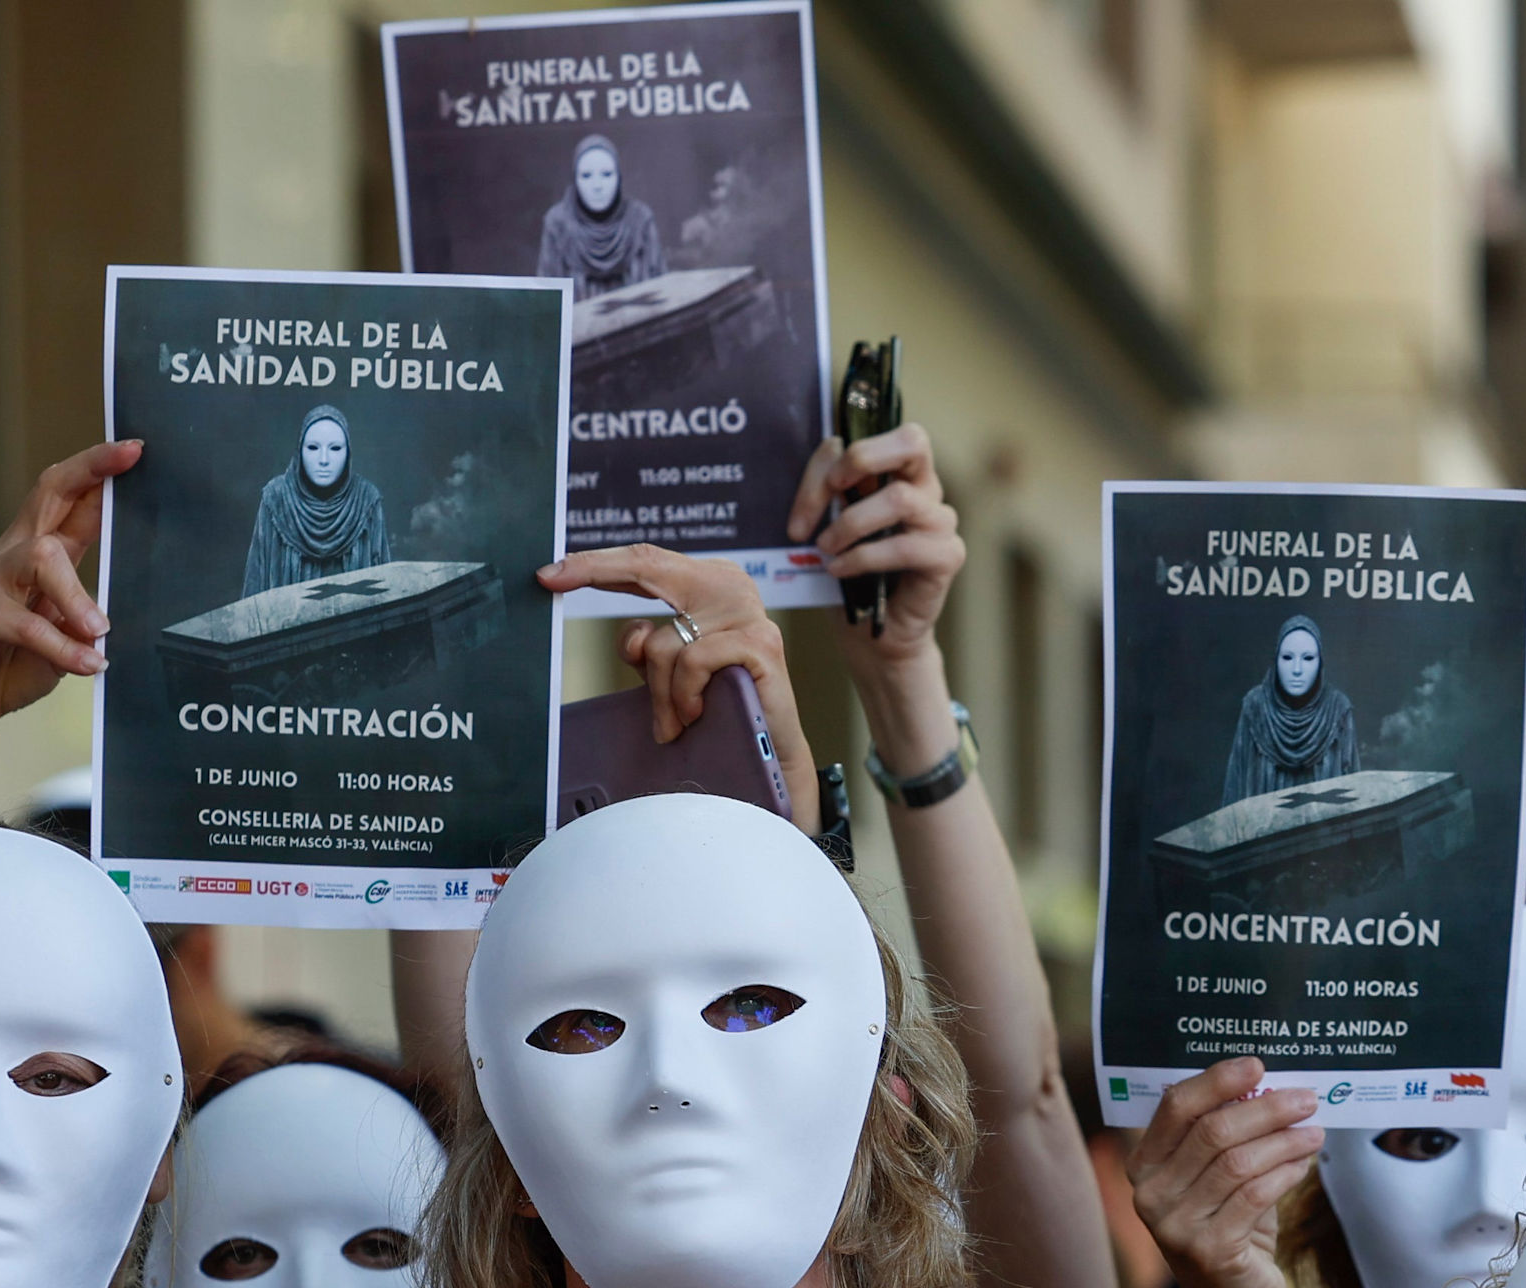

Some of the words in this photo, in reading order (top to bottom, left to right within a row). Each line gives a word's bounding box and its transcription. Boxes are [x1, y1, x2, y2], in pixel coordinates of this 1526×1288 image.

[487, 55, 612, 89] FUNERAL
[620, 52, 658, 79] DE
[665, 48, 702, 76] LA
[455, 89, 596, 128] SANITAT
[608, 80, 752, 118] PÚBLICA
[216, 318, 350, 347] FUNERAL
[363, 323, 400, 348] DE
[412, 323, 448, 350] LA
[171, 353, 337, 387] SANIDAD
[350, 351, 504, 392] PÚBLICA
[571, 398, 747, 441] CENTRACIÓ
[639, 467, 681, 486] 11:00
[684, 464, 744, 483] HORES
[637, 506, 661, 523] DE
[664, 502, 737, 522] SANITAT
[1207, 530, 1324, 558] FUNERAL
[1335, 533, 1372, 559] DE
[1382, 534, 1419, 561] LA
[1167, 566, 1311, 597] SANIDAD
[1323, 561, 1474, 603] PÚBLICA
[178, 703, 473, 740] CONCENTRACIÓN
[195, 768, 203, 784] 1
[209, 768, 232, 786] DE
[238, 769, 298, 788] JUNIO
[338, 772, 381, 791] 11:00
[388, 774, 454, 793] HORAS
[198, 808, 323, 830] CONSELLERIA
[329, 814, 353, 831] DE
[359, 815, 445, 834] SANIDAD
[209, 833, 247, 846] (CALLE
[251, 835, 287, 847] MICER
[289, 834, 332, 848] MASCÓ
[336, 838, 368, 851] 31-33,
[197, 879, 237, 892] CCOO
[257, 881, 292, 896] UGT
[370, 887, 392, 896] CSIF
[445, 881, 469, 897] SAE
[1164, 911, 1441, 947] CONCENTRACIÓN
[1176, 975, 1184, 993] 1
[1188, 976, 1209, 994] DE
[1213, 977, 1268, 996] JUNIO
[1306, 979, 1348, 997] 11:00
[1353, 980, 1419, 998] HORAS
[1177, 1016, 1291, 1037] CONSELLERIA
[1297, 1021, 1321, 1037] DE
[1325, 1020, 1409, 1037] SANIDAD
[1186, 1041, 1220, 1054] (CALLE
[1224, 1043, 1255, 1055] MICER
[1258, 1041, 1300, 1056] MASCÓ
[1303, 1044, 1334, 1057] 31-33,
[1405, 1081, 1428, 1096] SAE
